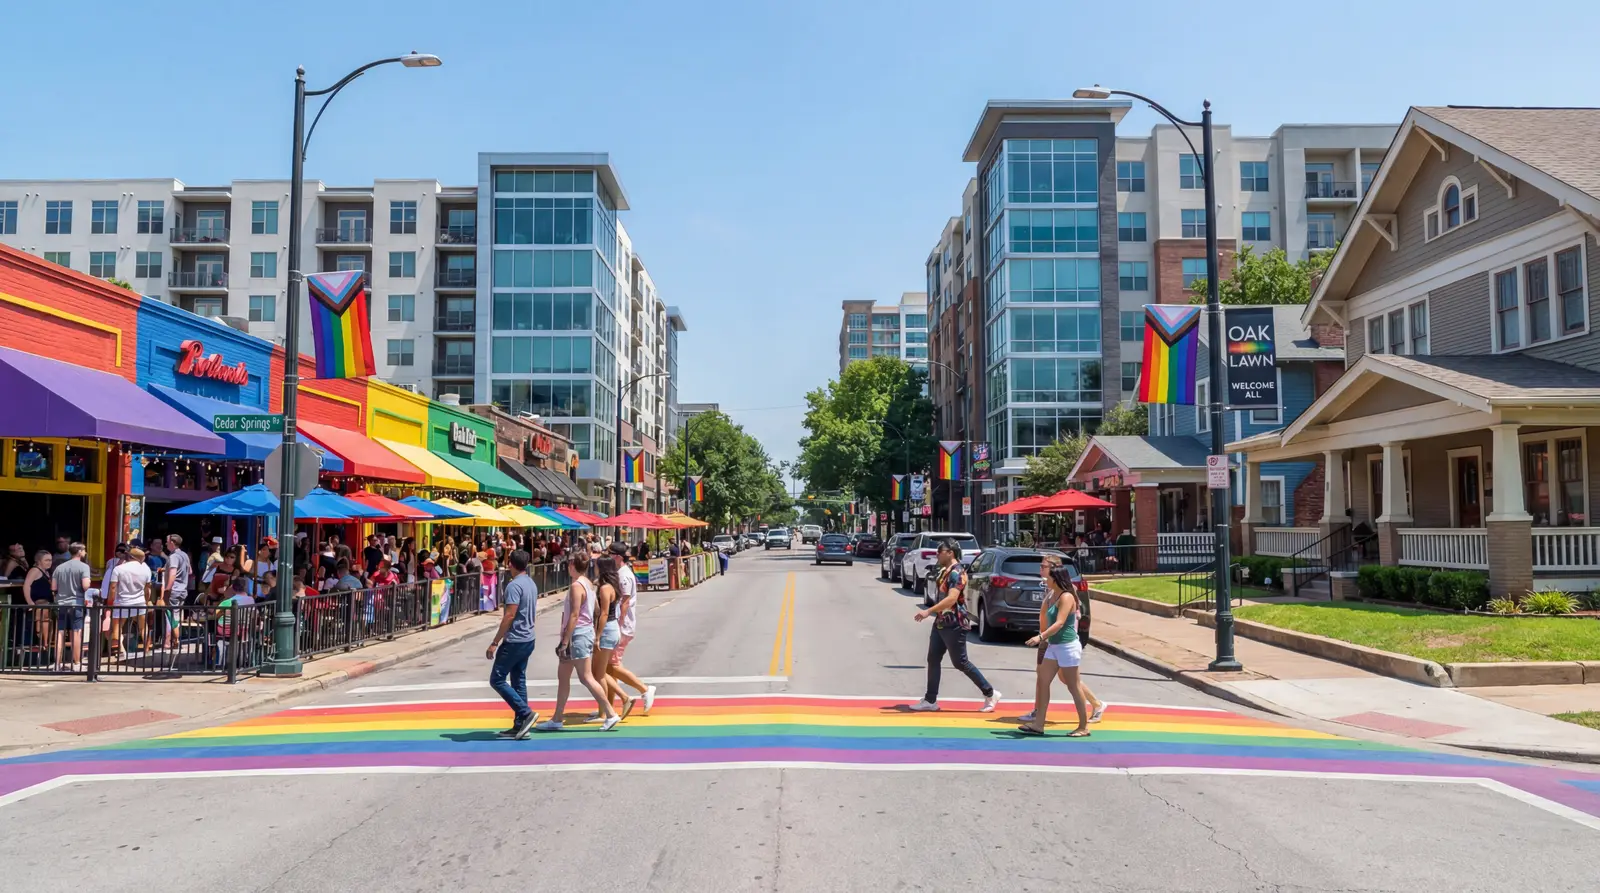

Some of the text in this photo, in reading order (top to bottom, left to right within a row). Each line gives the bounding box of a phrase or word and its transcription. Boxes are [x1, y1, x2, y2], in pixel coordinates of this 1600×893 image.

[1228, 325, 1271, 341] OAK
[1230, 354, 1274, 367] LAWN
[1231, 382, 1275, 390] WELCOME
[1245, 391, 1262, 399] ALL
[215, 417, 238, 429] Cedar
[240, 417, 271, 431] Springs
